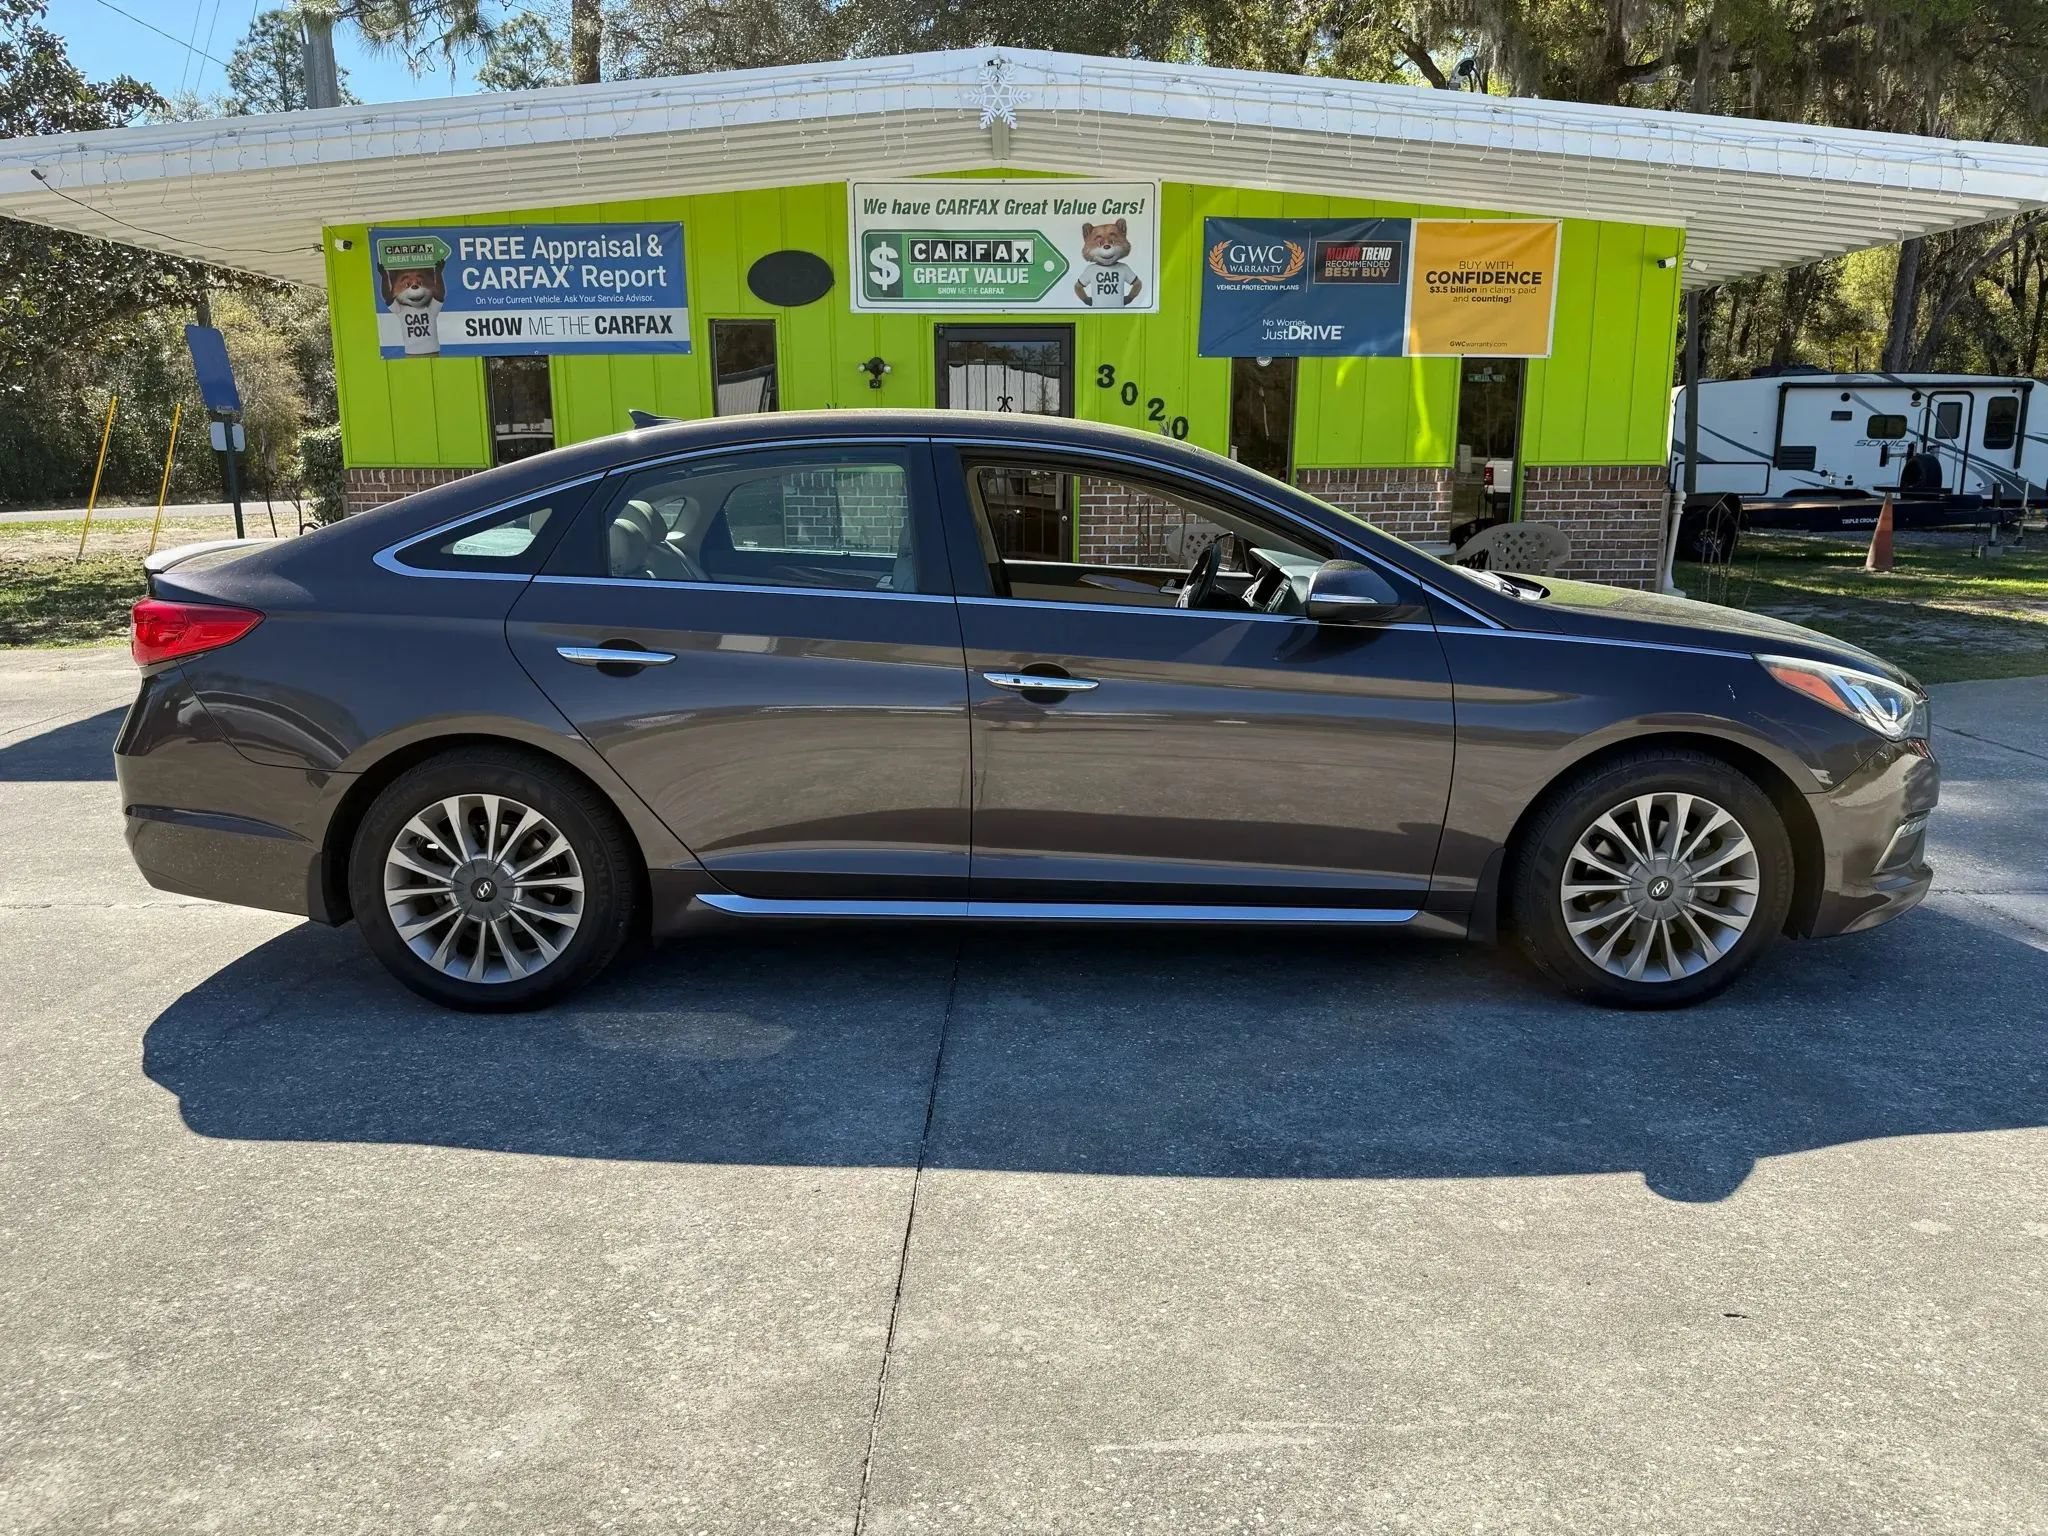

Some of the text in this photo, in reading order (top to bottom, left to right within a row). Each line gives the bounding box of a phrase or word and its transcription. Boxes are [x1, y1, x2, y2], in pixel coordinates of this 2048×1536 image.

[863, 198, 1145, 215] We have CARFAX Great Value Cars!
[386, 245, 433, 254] CARFAX
[459, 233, 664, 265] FREE Appraisal &
[913, 243, 1030, 263] CARFAX
[1229, 245, 1284, 264] GWC
[1326, 246, 1392, 261] MOTOR TREND
[387, 254, 434, 263] GREAT VALUE
[1325, 260, 1390, 268] RECOMMENDED
[1230, 265, 1282, 273] WARRANTY
[1459, 261, 1514, 270] BUY WITH
[913, 267, 1029, 284] GREAT VALUE
[1095, 271, 1120, 283] CAR
[1324, 268, 1389, 277] BEST BUY
[1425, 270, 1543, 285] CONFIDENCE
[581, 265, 667, 293] Report
[937, 287, 957, 295] SHOW
[957, 287, 966, 295] ME
[1096, 283, 1120, 295] FOX
[1429, 286, 1537, 295] $3.5 billion in claims paid
[476, 294, 655, 304] On Your Current Vehicle. Ask Your Service Advisor.
[1453, 295, 1512, 304] and counting!
[404, 313, 430, 326] CAR
[465, 315, 673, 336] SHOW ME THE CARFAX
[1262, 319, 1275, 327] No
[407, 326, 431, 338] FOX
